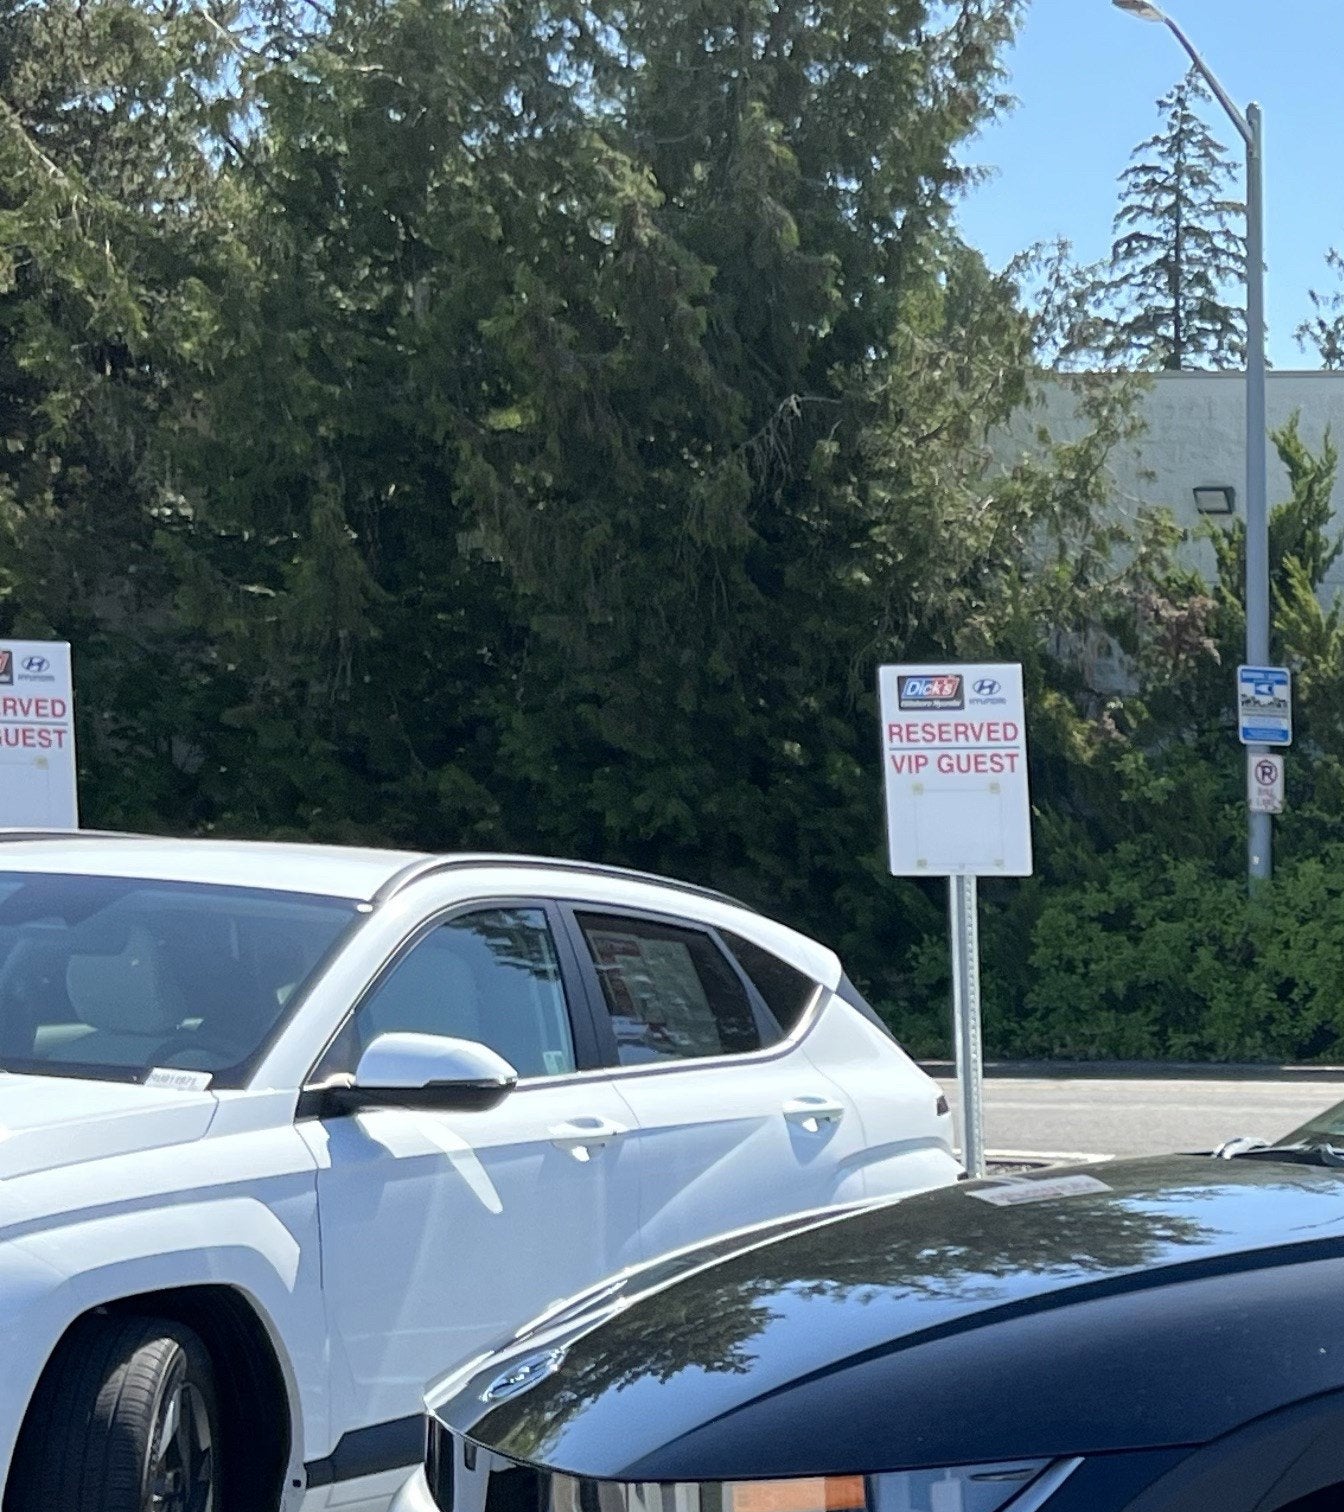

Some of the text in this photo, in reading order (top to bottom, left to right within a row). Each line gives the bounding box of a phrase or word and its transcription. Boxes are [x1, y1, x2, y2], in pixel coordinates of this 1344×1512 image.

[0, 697, 66, 718] RVED
[0, 728, 68, 748] UEST
[888, 722, 1019, 743] RESERVED
[891, 753, 1019, 774] VIP GUEST
